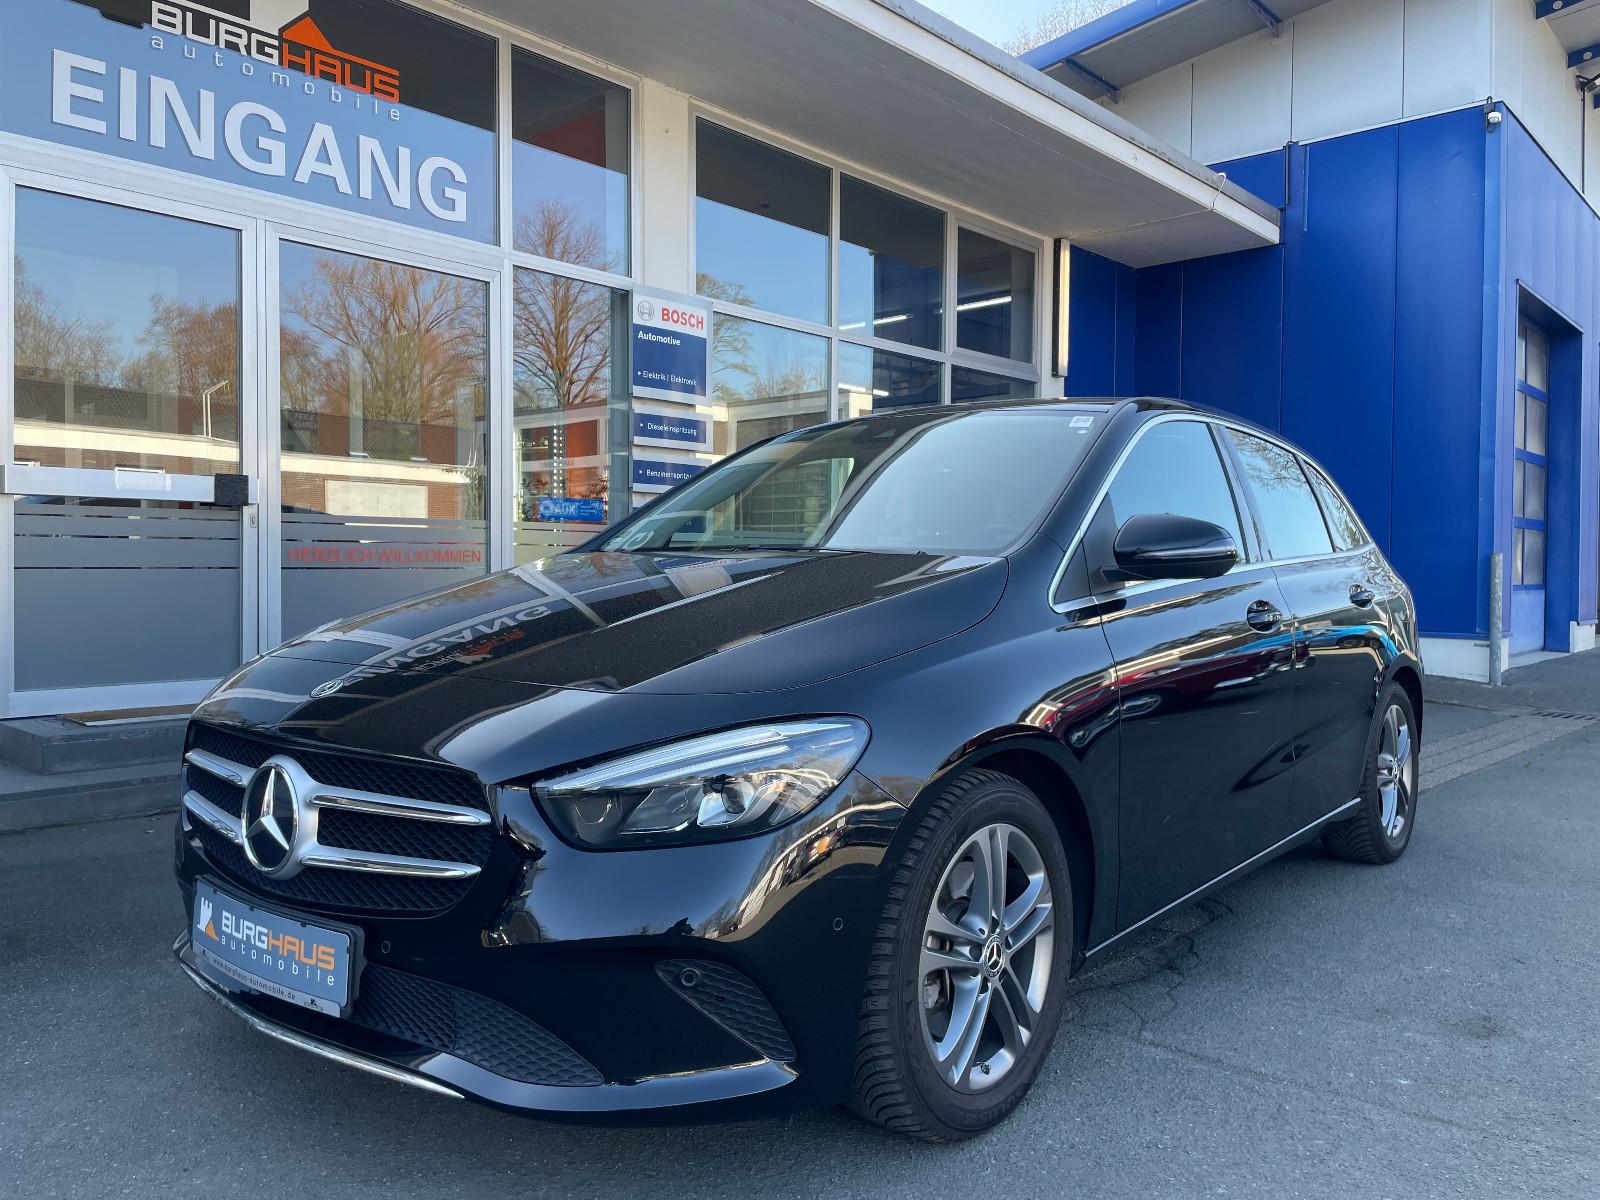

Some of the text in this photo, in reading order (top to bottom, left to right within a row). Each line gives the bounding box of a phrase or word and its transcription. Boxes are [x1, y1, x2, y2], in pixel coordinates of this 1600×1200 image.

[151, 2, 400, 104] BURGHAUS
[152, 35, 400, 120] automobile
[52, 48, 468, 222] EINGANG
[661, 307, 704, 330] BOSCH
[638, 330, 681, 346] Automotive
[642, 370, 666, 381] Elektrik
[670, 374, 697, 386] Elektronik
[647, 422, 697, 437] Dieseleinspritzung
[289, 545, 481, 563] HERZLICH WILLKOMMEN
[221, 910, 336, 970] BURGHAUS
[221, 935, 335, 986] automobile
